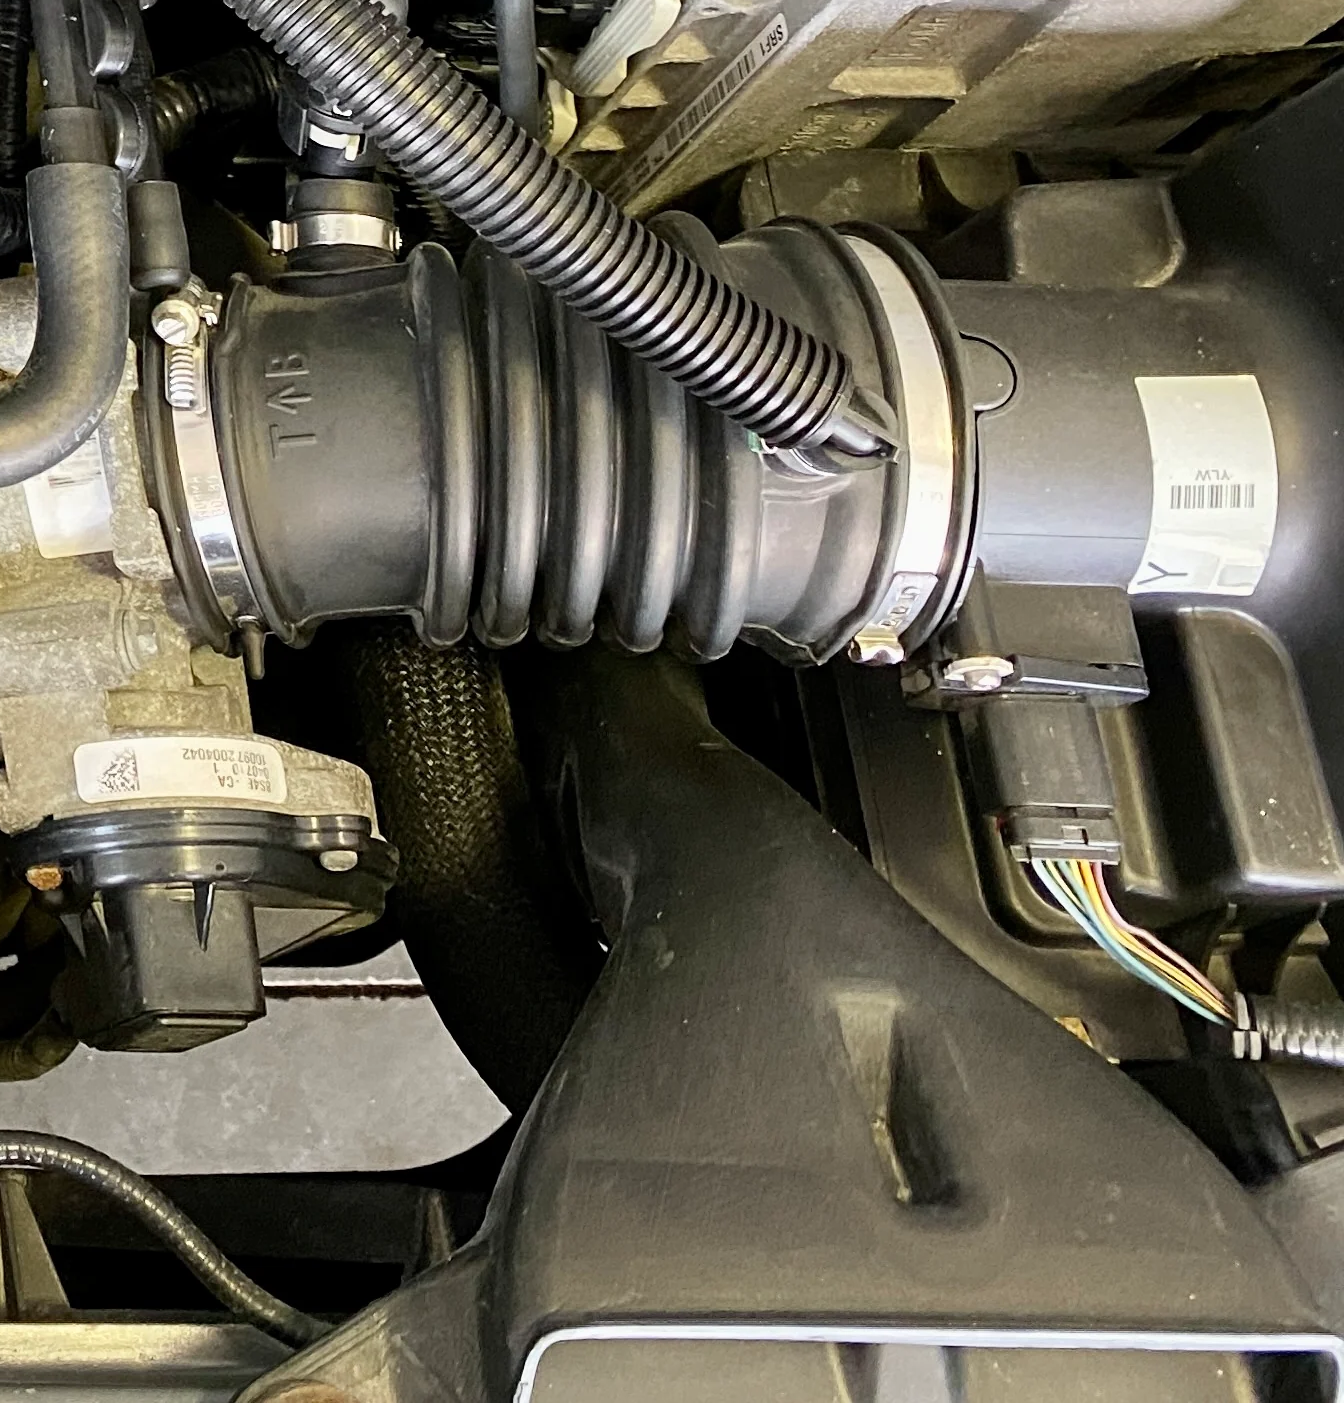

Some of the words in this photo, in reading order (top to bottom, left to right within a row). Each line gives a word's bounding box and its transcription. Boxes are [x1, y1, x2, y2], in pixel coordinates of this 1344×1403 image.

[759, 24, 784, 56] SRF1
[1194, 468, 1231, 482] YLW
[1136, 561, 1189, 586] Y
